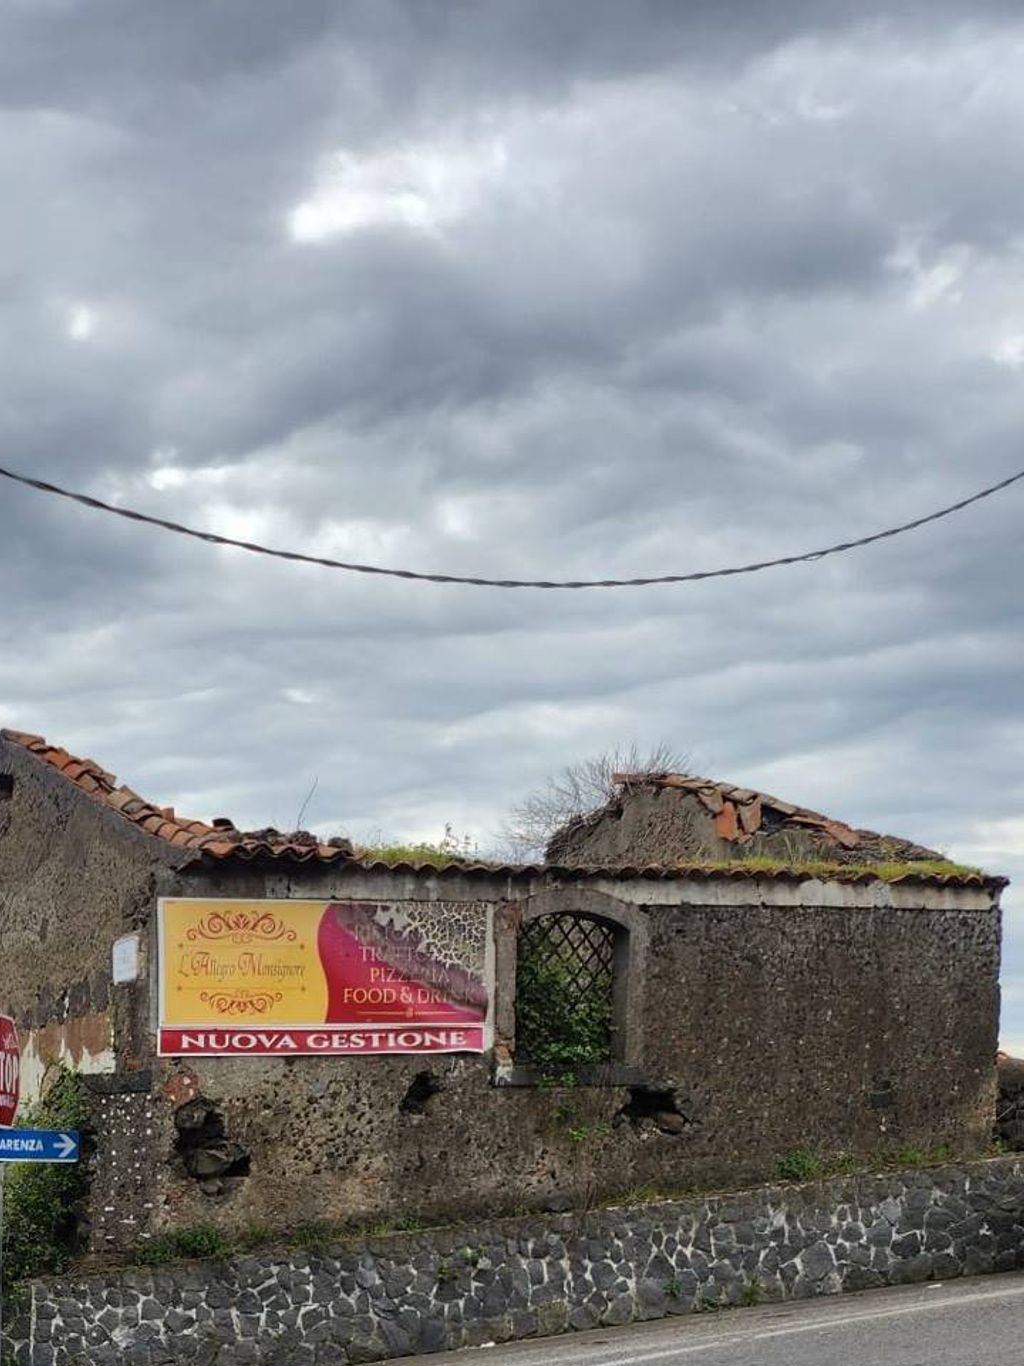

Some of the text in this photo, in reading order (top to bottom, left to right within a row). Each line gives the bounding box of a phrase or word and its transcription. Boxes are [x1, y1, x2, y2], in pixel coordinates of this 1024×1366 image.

[343, 988, 396, 1004] FOOD
[399, 986, 413, 1004] &
[181, 1032, 467, 1049] NUOVA GESTIONE
